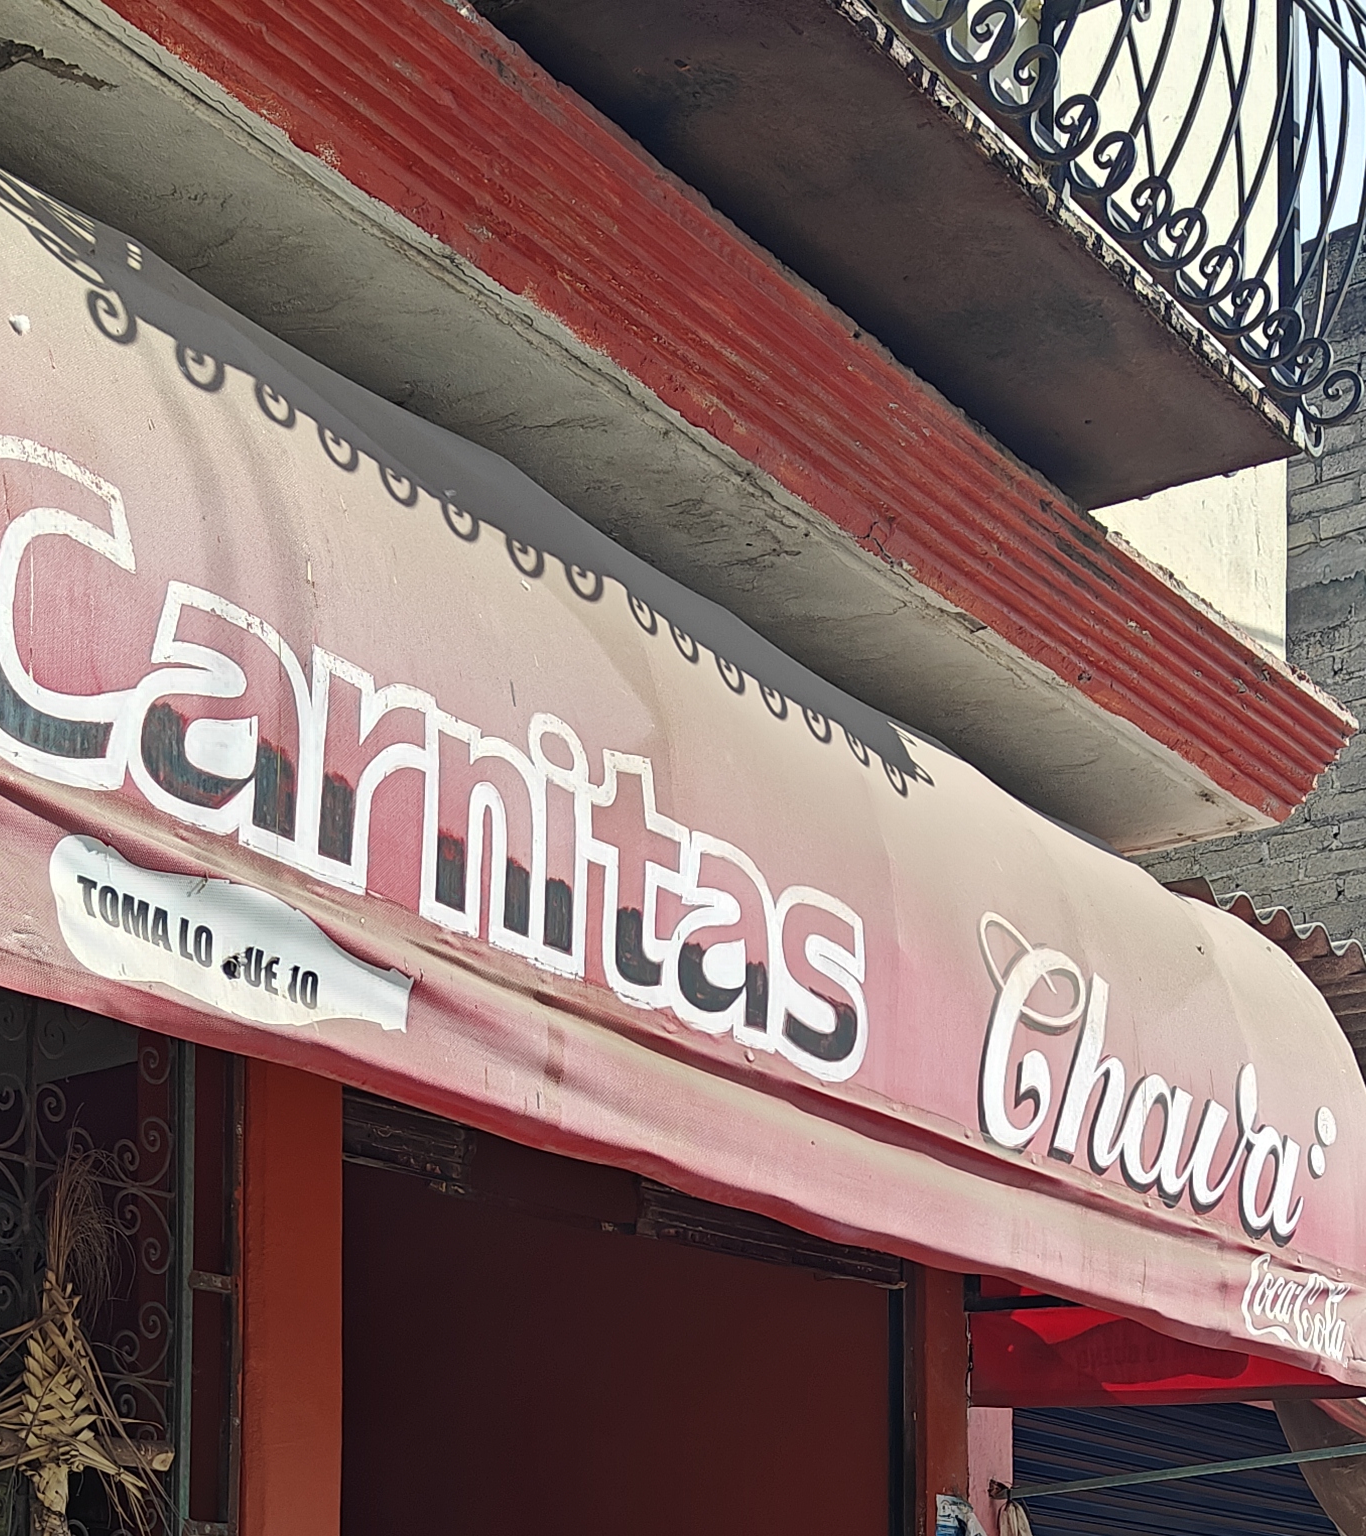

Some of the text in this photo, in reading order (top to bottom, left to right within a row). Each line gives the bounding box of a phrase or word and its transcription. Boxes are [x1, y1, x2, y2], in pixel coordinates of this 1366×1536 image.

[76, 874, 173, 953] TOMA
[178, 916, 214, 969] LO
[1241, 1252, 1351, 1362] Coca-Cola
